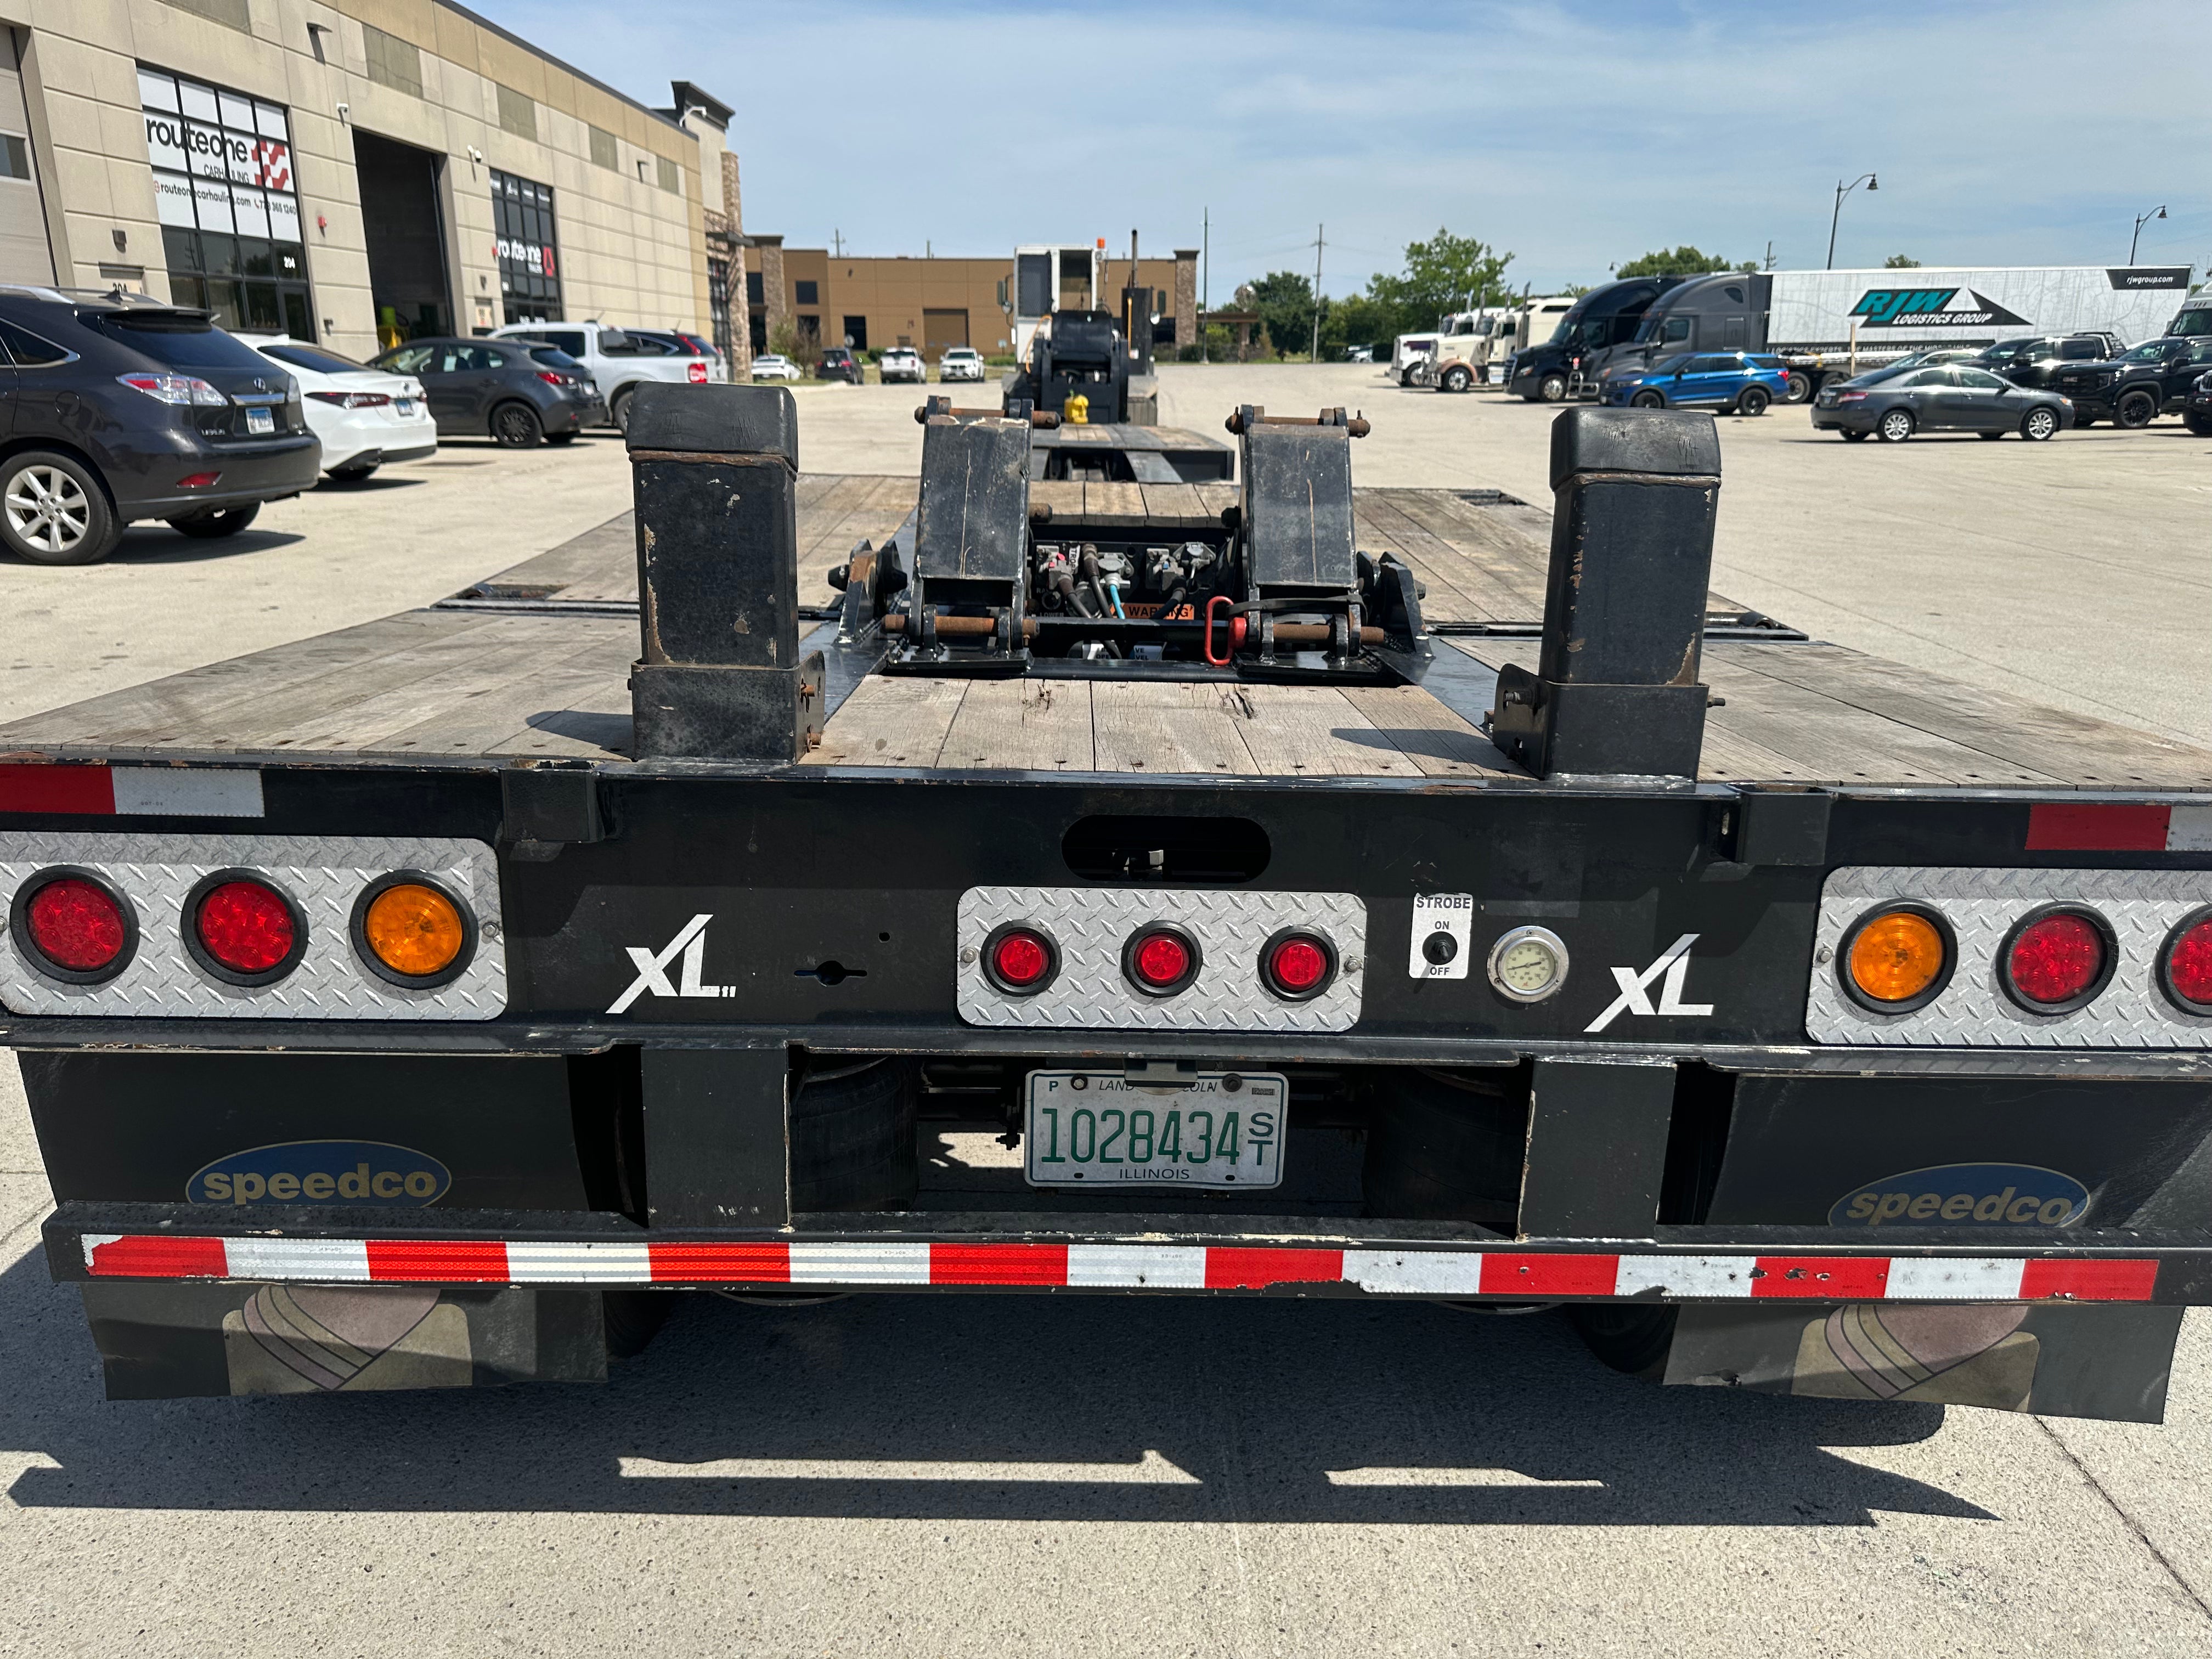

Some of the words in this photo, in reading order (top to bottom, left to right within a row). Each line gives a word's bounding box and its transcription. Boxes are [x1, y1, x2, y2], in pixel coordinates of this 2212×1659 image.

[146, 118, 248, 163] routeone
[2126, 275, 2174, 285] rjwgroup.com
[1856, 291, 1953, 322] RJW
[1892, 313, 1950, 325] LOGISTICS
[1951, 312, 1993, 324] GROUP
[1416, 896, 1471, 909] STROBE
[1435, 921, 1449, 930] ON
[1430, 967, 1450, 976] OFF
[1583, 934, 1714, 1032] XL
[1048, 1081, 1059, 1092] P
[1041, 1108, 1240, 1165] 1028434
[1119, 1168, 1190, 1180] ILLINOIS
[203, 1163, 438, 1205] speedco
[1846, 1186, 2073, 1226] speedco
